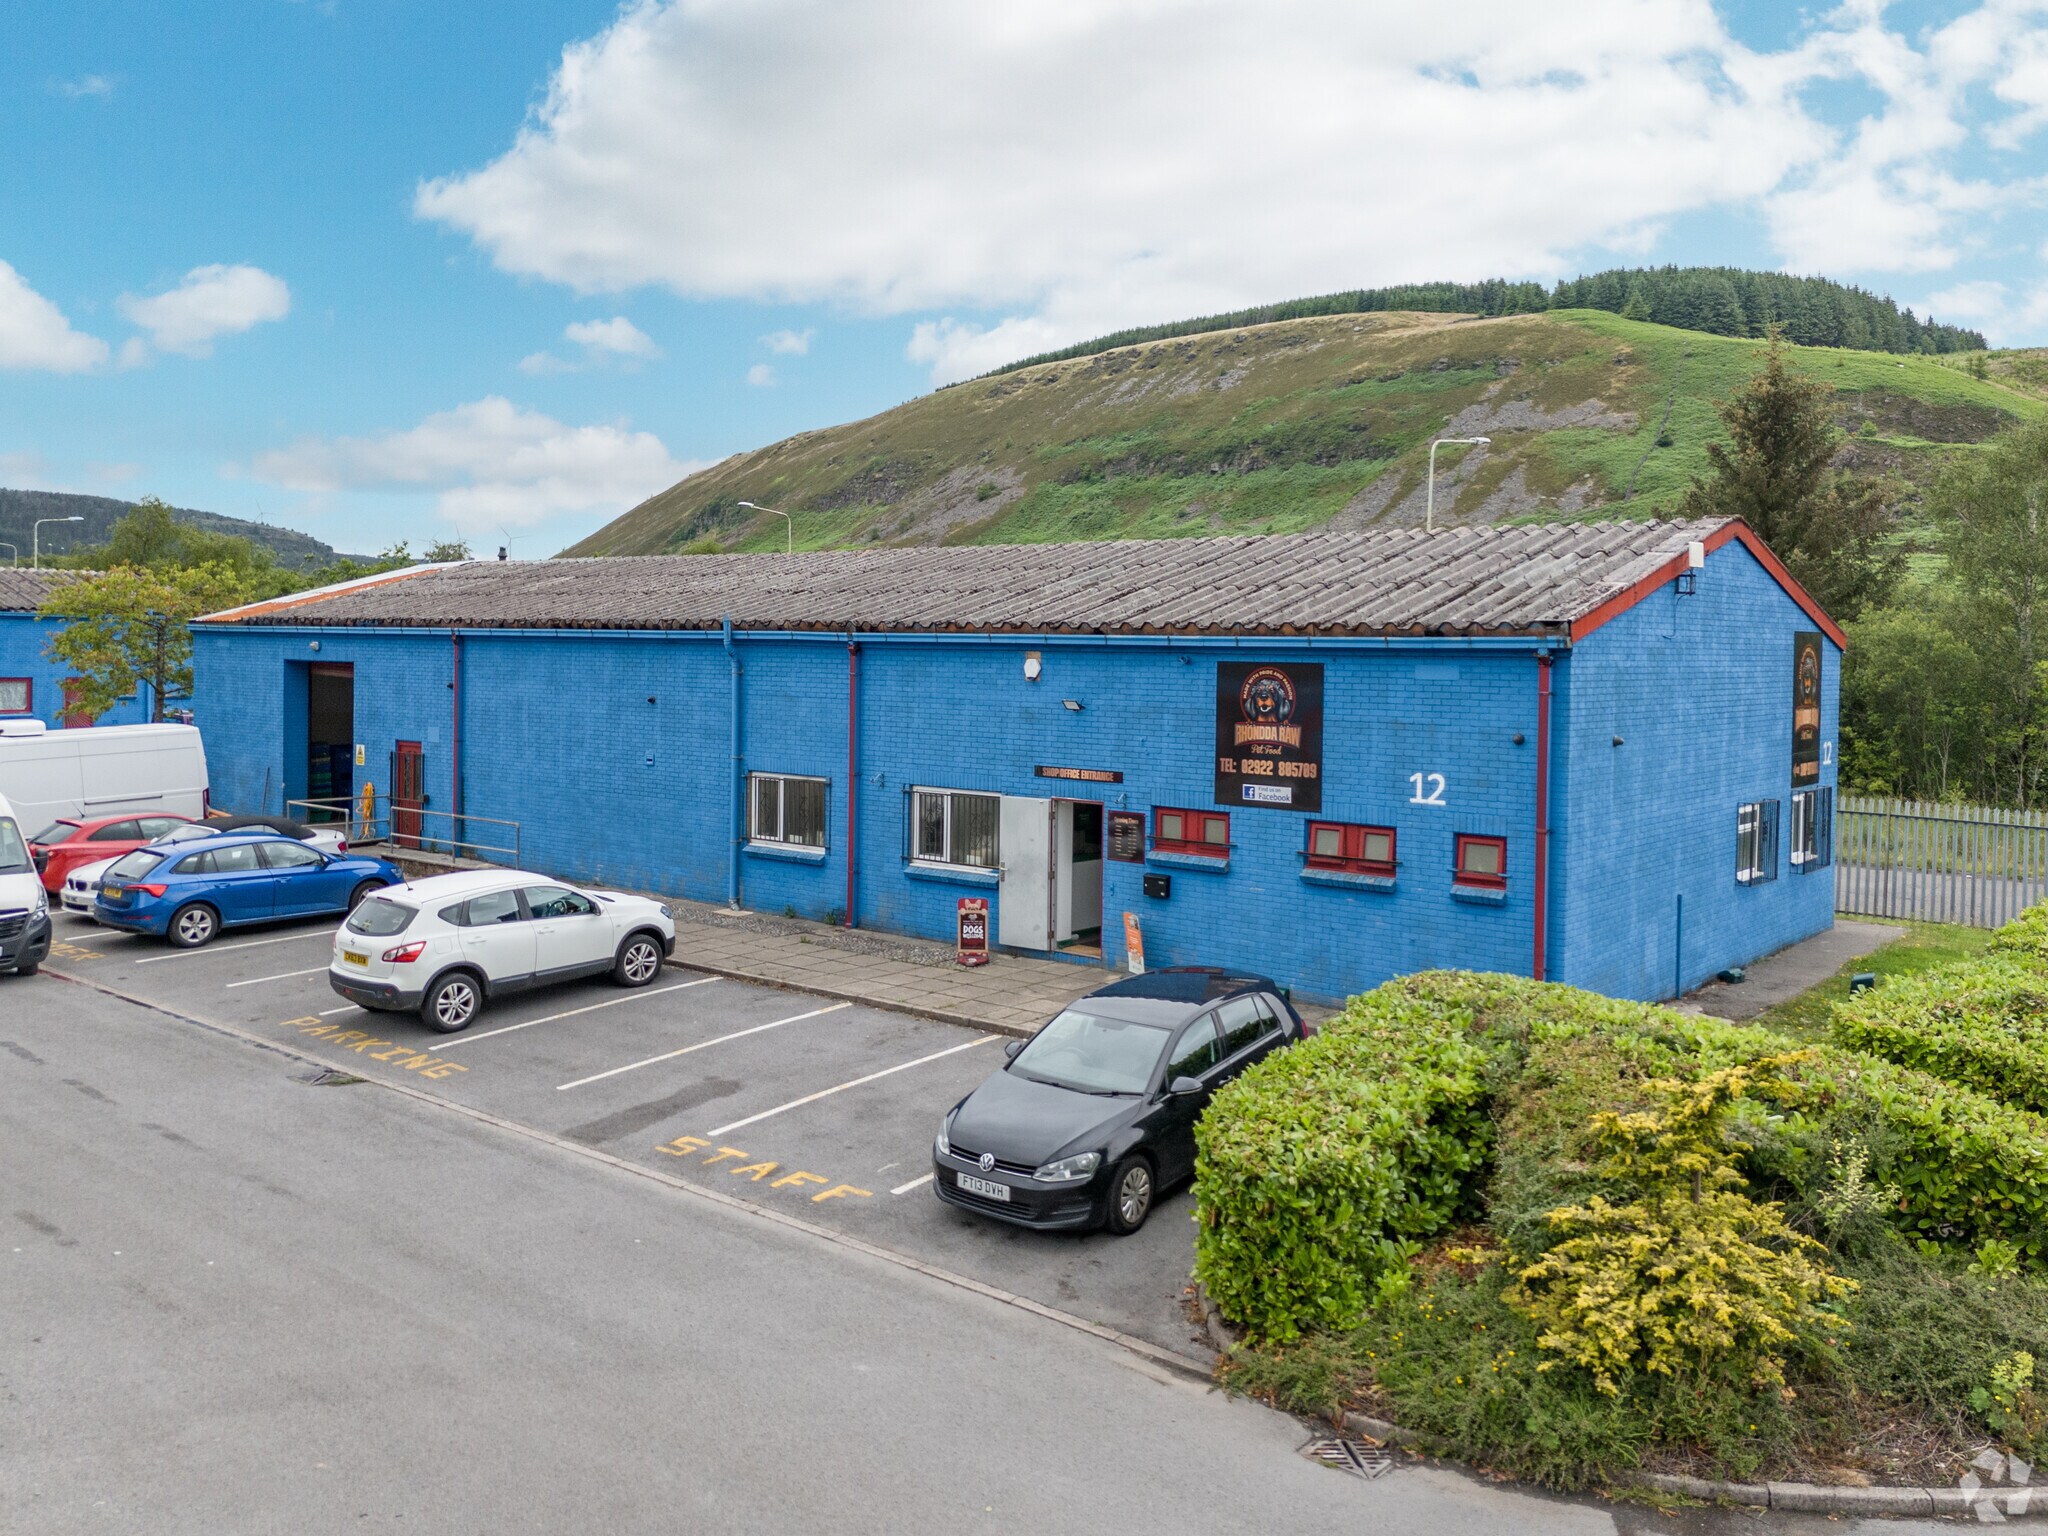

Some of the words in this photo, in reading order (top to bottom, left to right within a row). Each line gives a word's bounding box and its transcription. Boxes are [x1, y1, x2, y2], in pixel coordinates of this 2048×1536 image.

[1248, 672, 1260, 684] WITH
[1274, 671, 1284, 680] AND
[1236, 724, 1278, 744] RHONDDA
[1279, 725, 1301, 748] RAW
[1252, 744, 1264, 754] Pet
[1264, 745, 1283, 756] Food
[1822, 741, 1832, 765] 12
[1042, 767, 1060, 777] SHOP
[1059, 768, 1080, 779] OFFICE
[1081, 770, 1115, 782] ENTRANCE
[1220, 758, 1237, 773] TEL:
[1259, 793, 1291, 802] Facebook
[1409, 772, 1446, 806] 12
[963, 925, 983, 934] DOGS
[279, 1015, 470, 1080] PARKING
[655, 1136, 875, 1205] STAFF
[962, 1175, 983, 1191] FT13
[985, 1181, 1004, 1198] DVH
